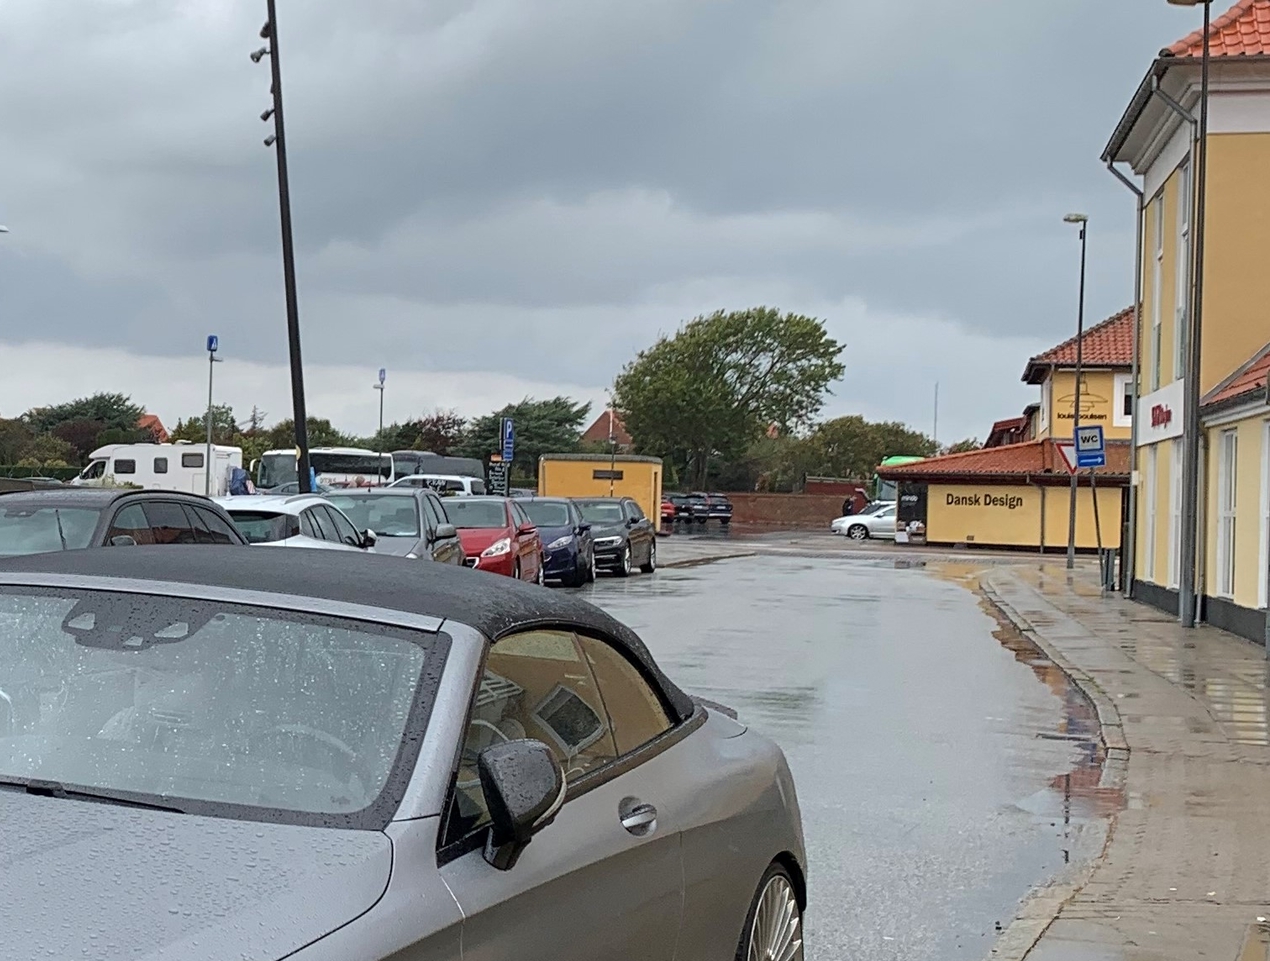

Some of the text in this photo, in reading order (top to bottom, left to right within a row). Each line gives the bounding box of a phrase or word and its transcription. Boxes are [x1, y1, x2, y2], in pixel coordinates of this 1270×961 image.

[506, 421, 512, 438] P
[1081, 435, 1098, 443] WC
[946, 493, 1023, 509] Dansk Design
